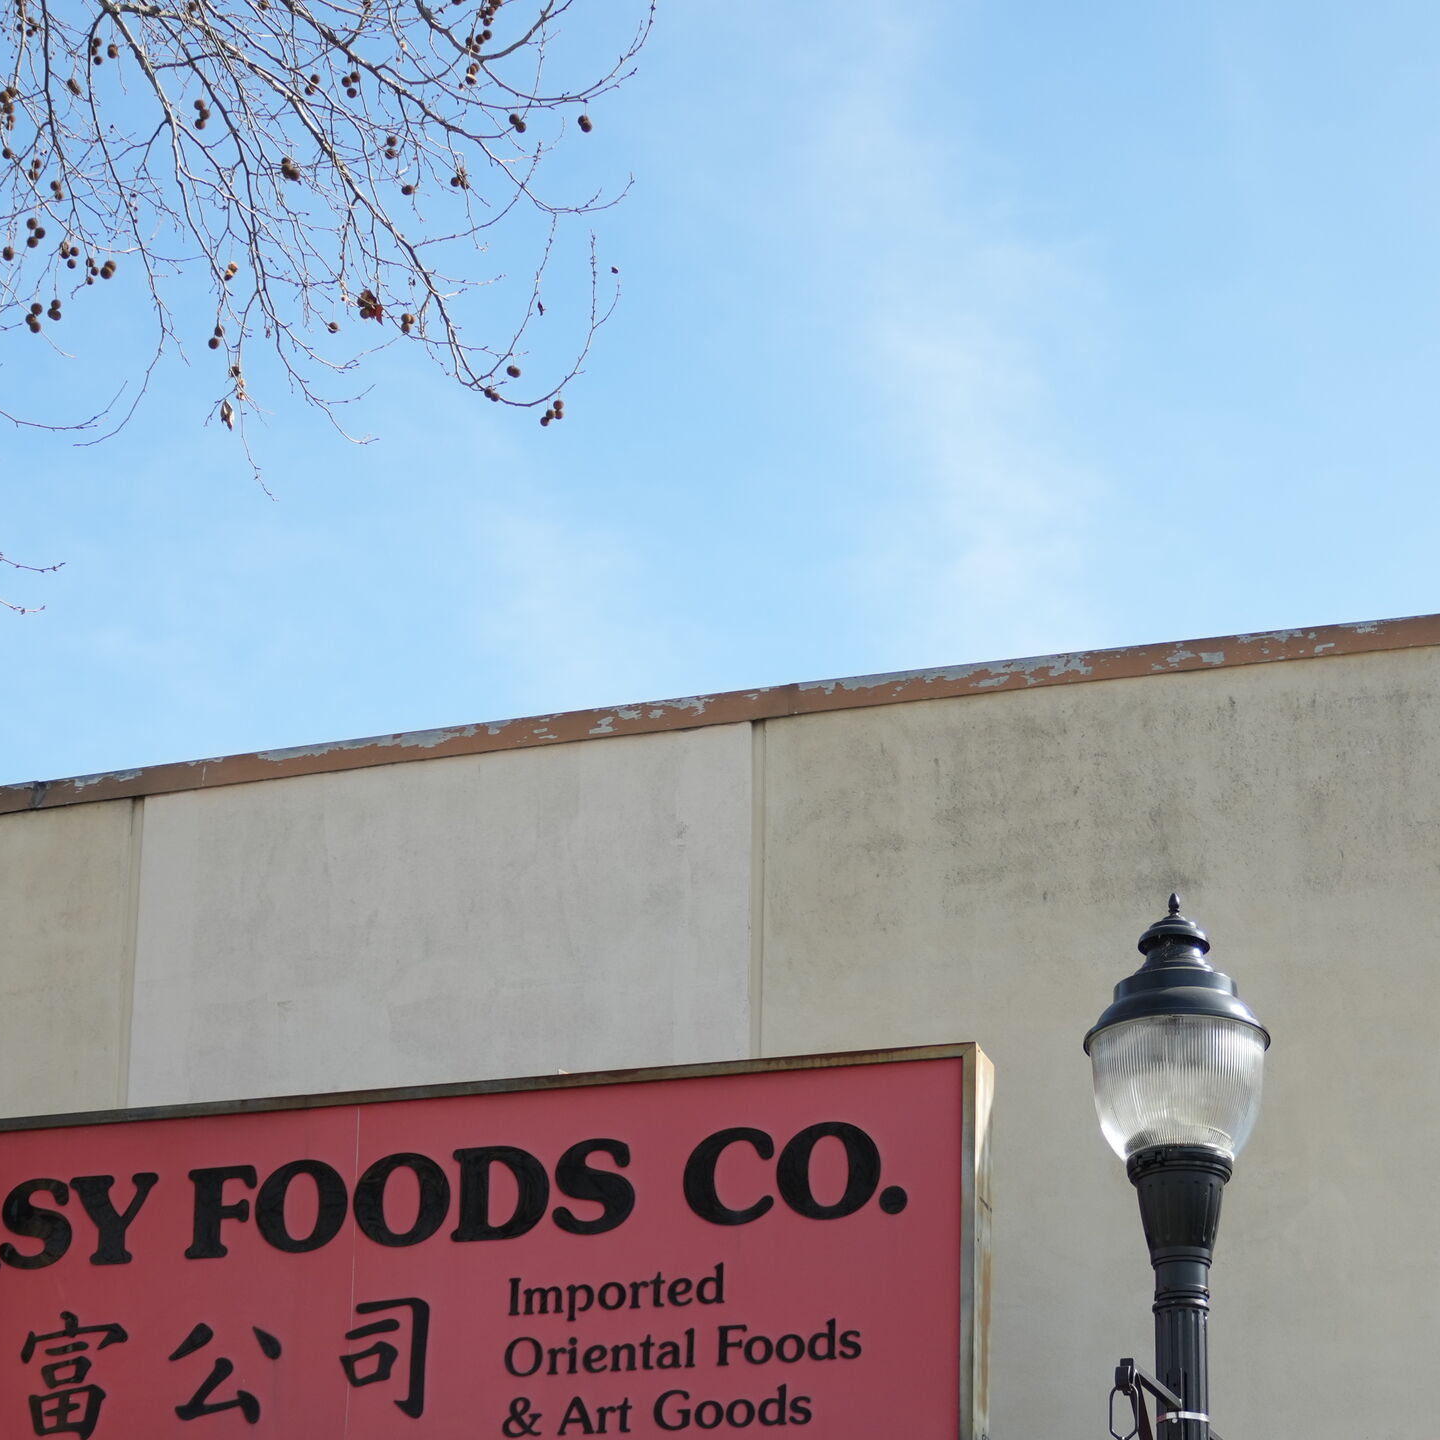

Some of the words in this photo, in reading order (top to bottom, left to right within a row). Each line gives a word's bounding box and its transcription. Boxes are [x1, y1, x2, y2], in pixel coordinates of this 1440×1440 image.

[185, 1137, 635, 1260] FOODS
[683, 1121, 907, 1226] CO.
[508, 1263, 726, 1322] Imported
[504, 1329, 695, 1377] Oriental
[716, 1319, 862, 1367] Foods
[502, 1397, 542, 1437] &
[557, 1396, 632, 1436] Art
[653, 1385, 812, 1432] Goods
